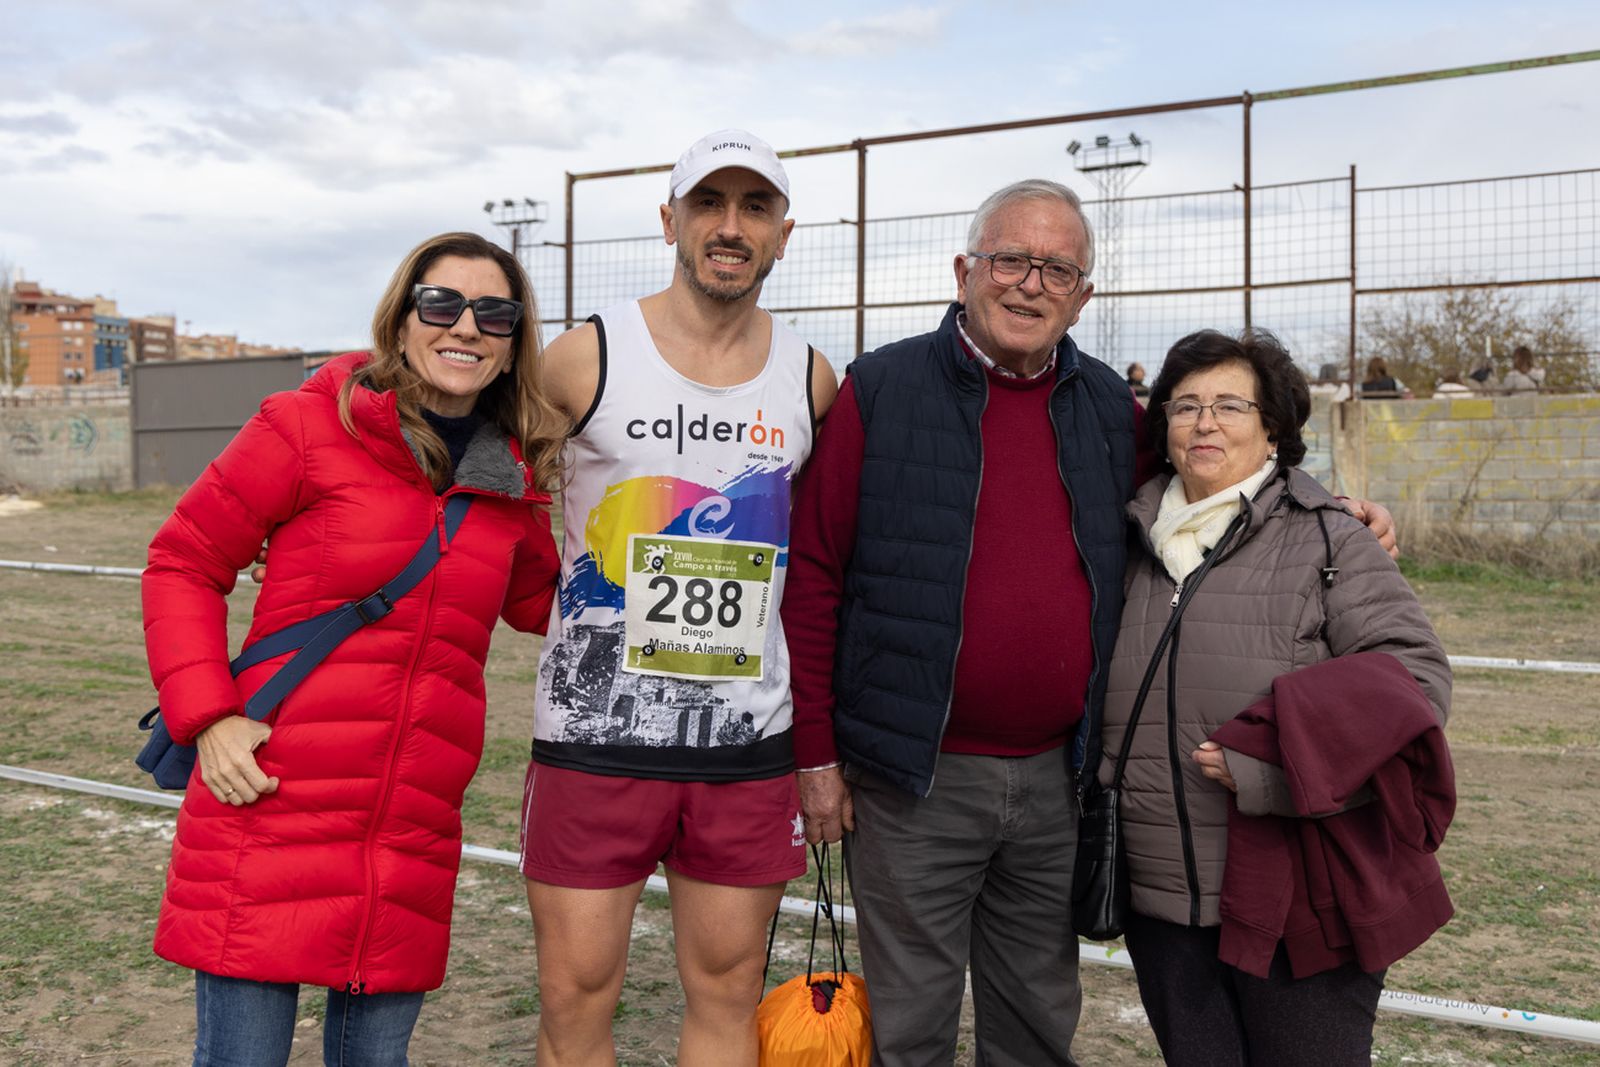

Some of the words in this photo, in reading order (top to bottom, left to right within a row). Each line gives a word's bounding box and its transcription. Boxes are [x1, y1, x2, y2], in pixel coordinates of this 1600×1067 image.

[712, 142, 751, 152] KIPRUN
[626, 404, 785, 455] calderón
[747, 452, 768, 461] desde
[673, 560, 705, 571] Campo
[645, 575, 743, 628] 288
[756, 586, 769, 628] Veterano
[681, 626, 714, 639] Diego
[649, 638, 690, 653] Mañas
[693, 641, 745, 656] Alaminos
